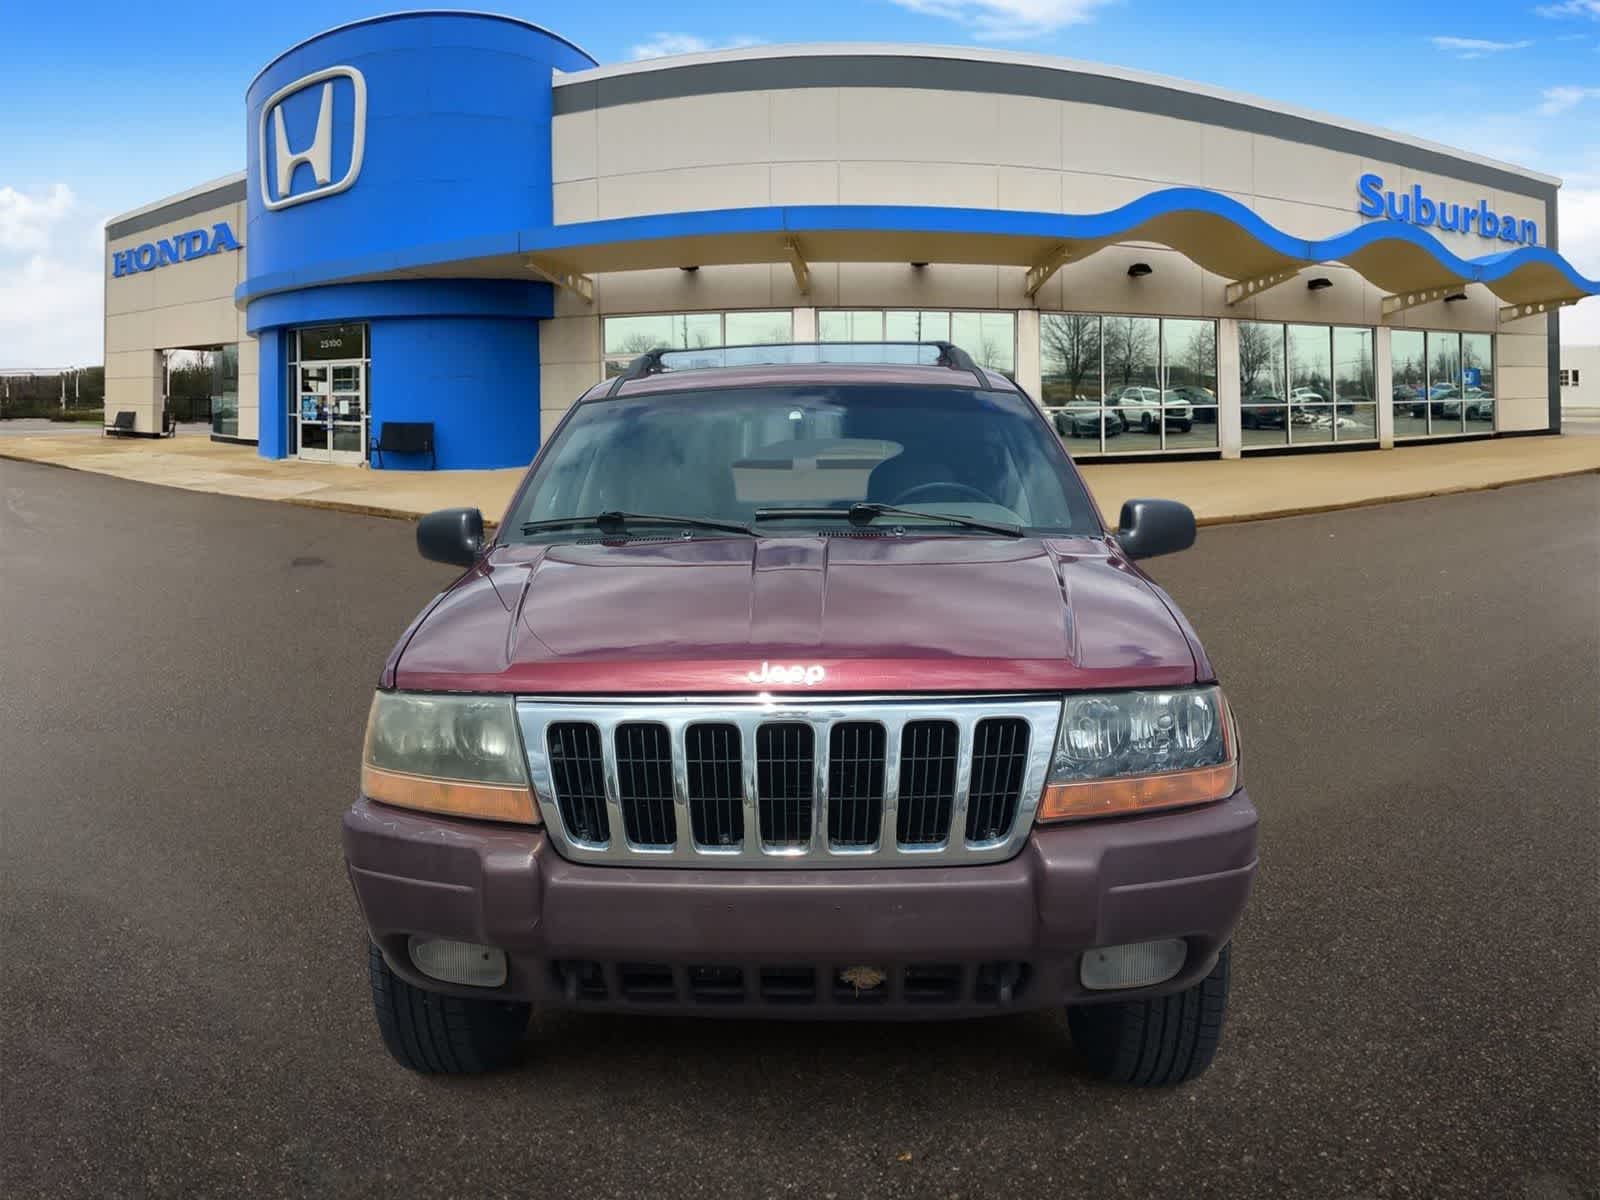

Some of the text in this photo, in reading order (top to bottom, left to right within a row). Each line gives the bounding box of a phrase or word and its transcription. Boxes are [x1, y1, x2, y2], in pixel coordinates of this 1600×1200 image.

[1358, 173, 1538, 245] Suburban
[112, 221, 240, 278] HONDA
[748, 660, 826, 686] Jeep
